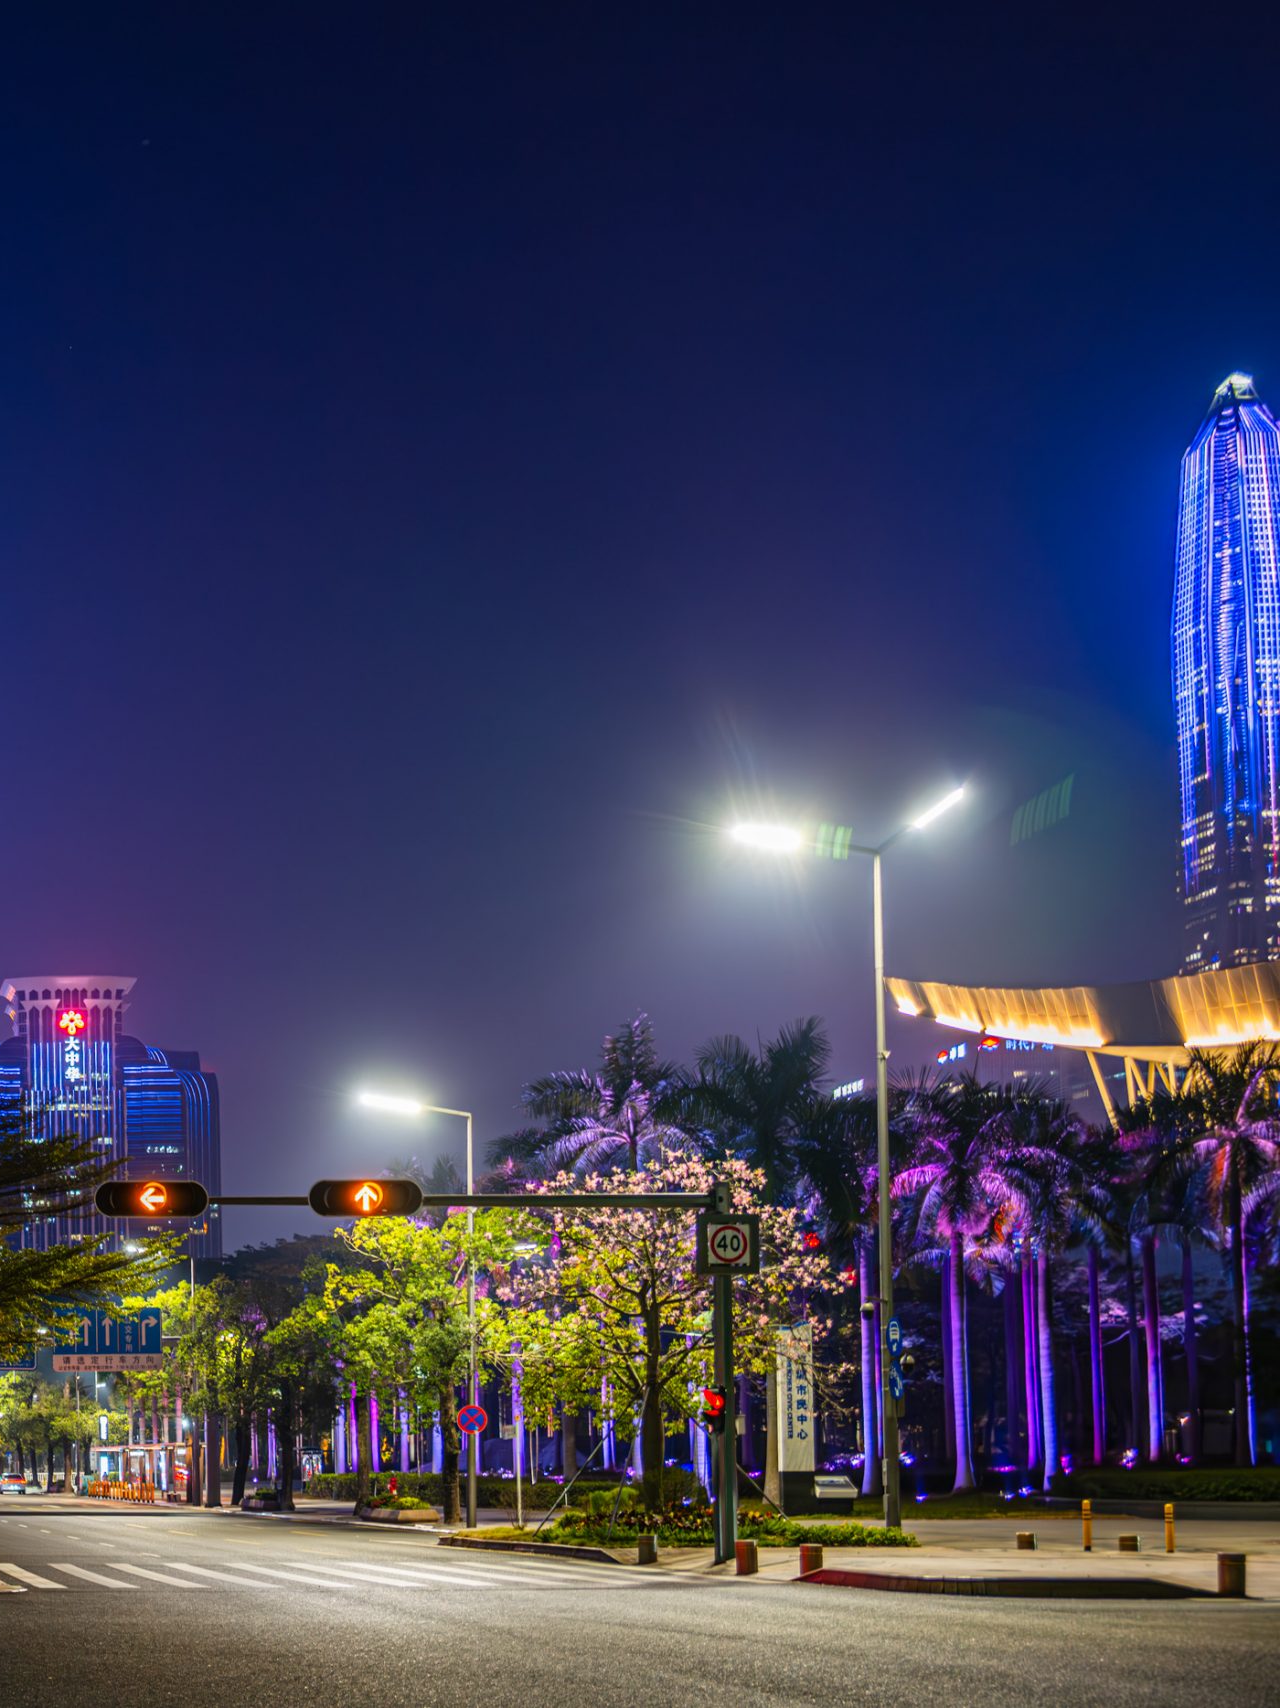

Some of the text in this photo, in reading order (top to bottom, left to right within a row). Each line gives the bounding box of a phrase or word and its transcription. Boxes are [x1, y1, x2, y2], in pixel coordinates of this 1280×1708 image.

[64, 1036, 80, 1082] 大中华
[717, 1234, 740, 1252] 40
